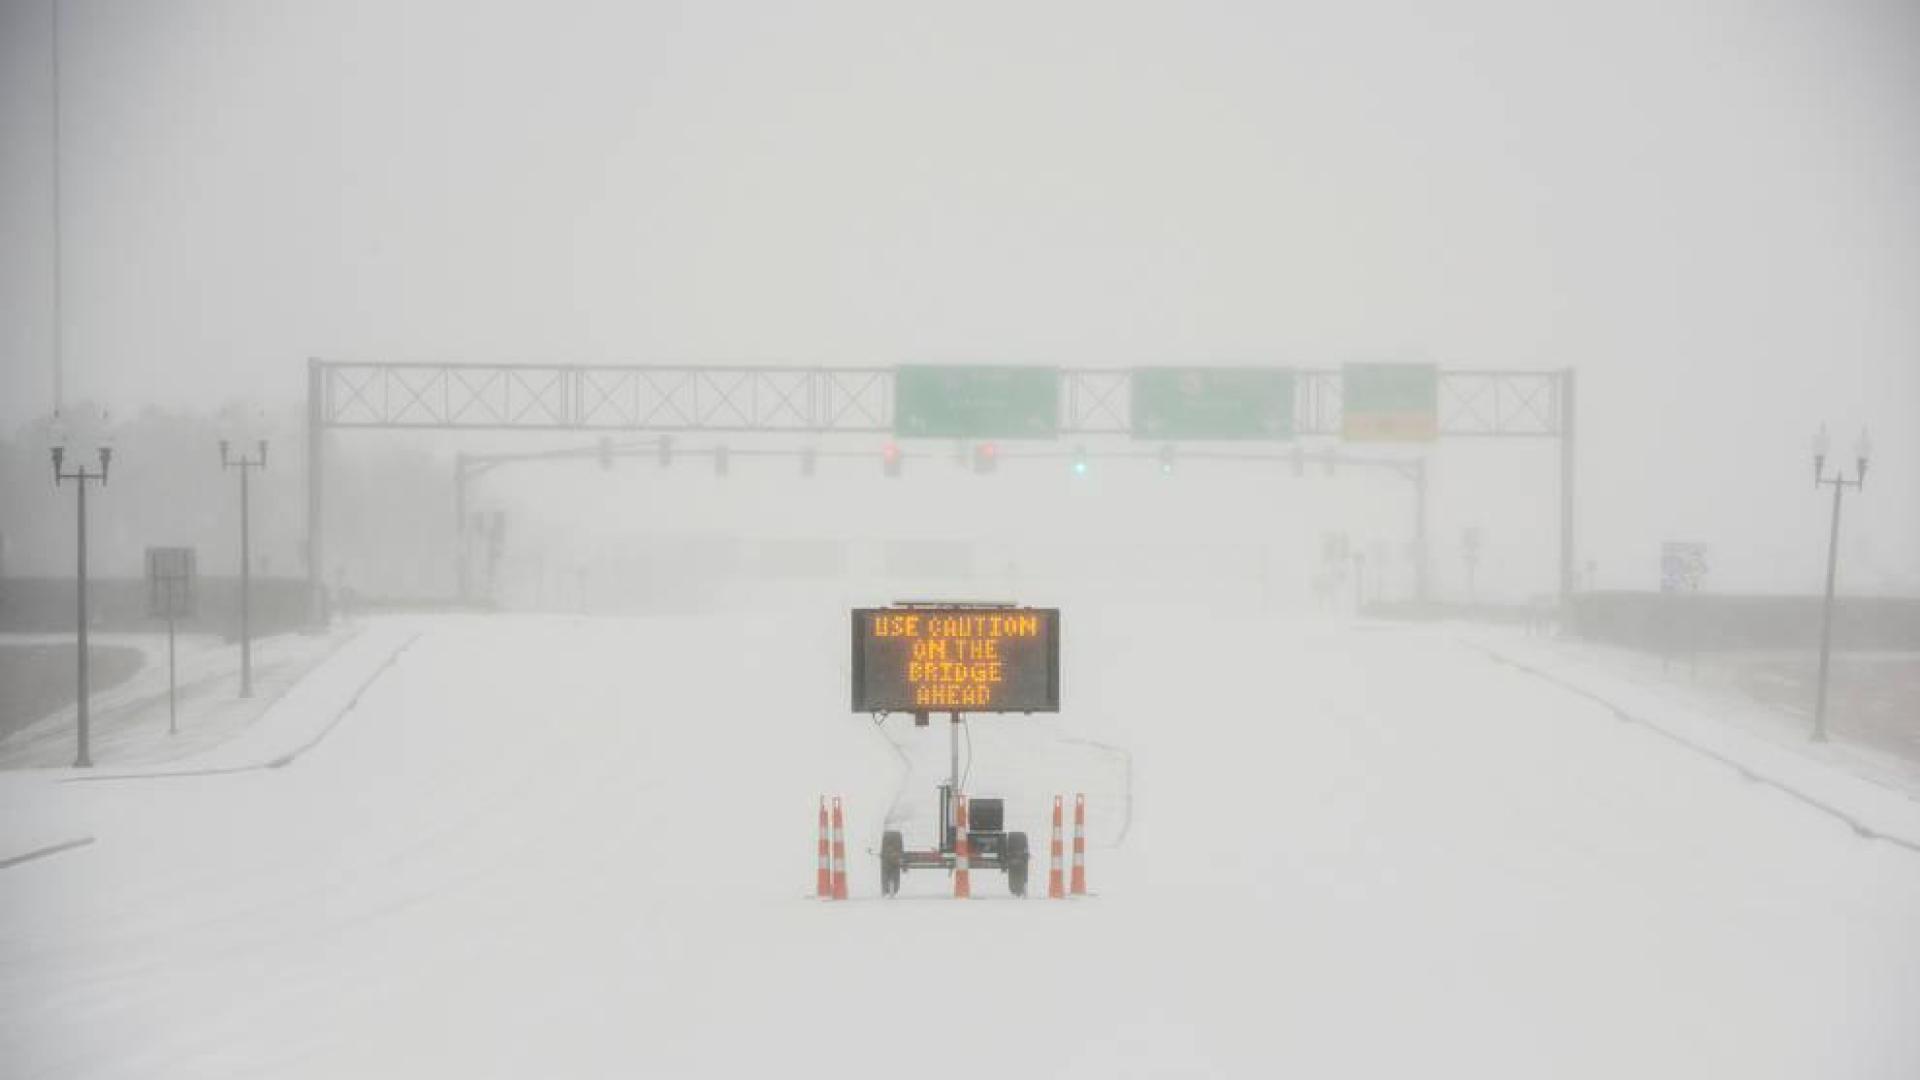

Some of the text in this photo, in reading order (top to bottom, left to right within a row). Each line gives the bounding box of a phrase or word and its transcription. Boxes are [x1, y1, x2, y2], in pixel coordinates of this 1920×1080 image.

[875, 616, 1037, 637] USE CAUTION
[913, 639, 999, 660] ON THE
[909, 662, 1002, 682] BRIDGE
[916, 685, 990, 705] AHEAD
